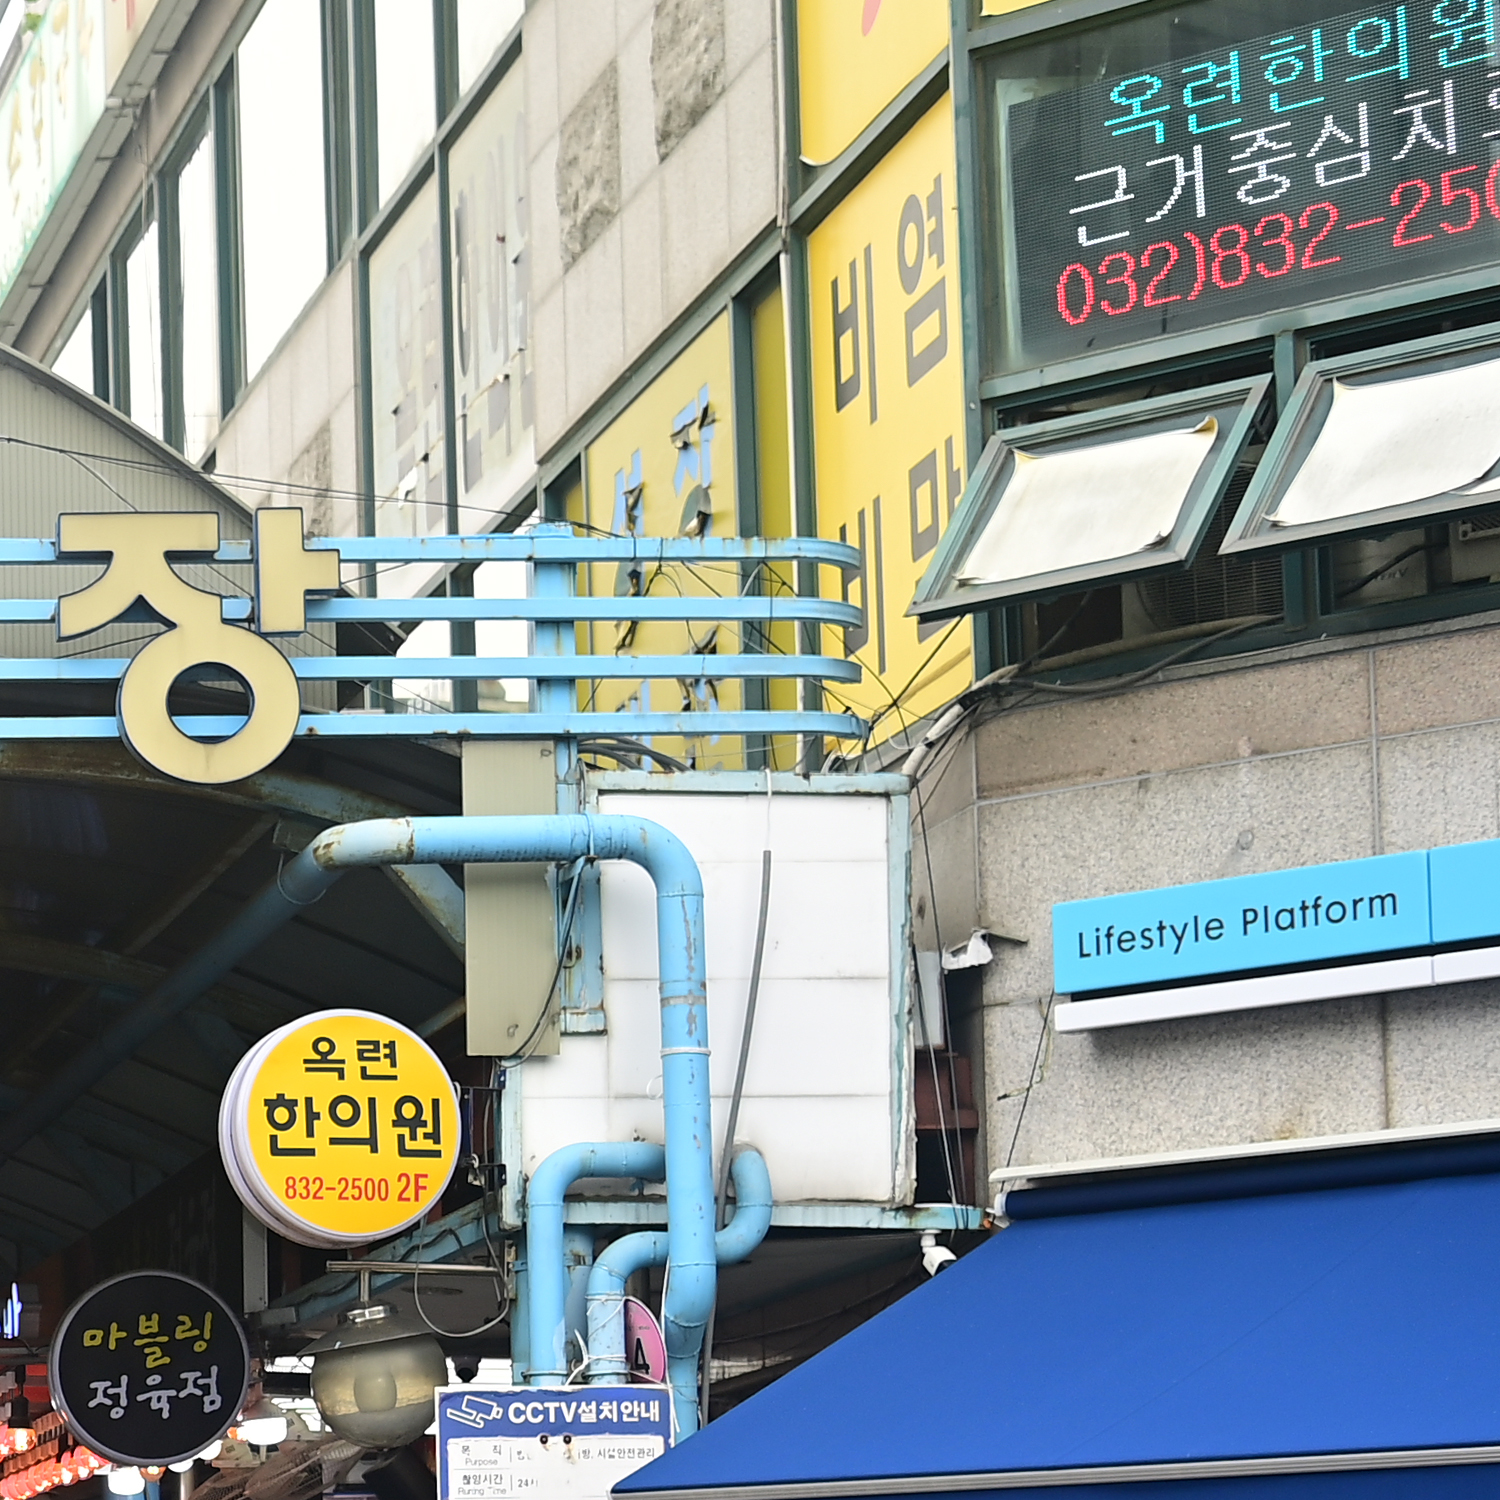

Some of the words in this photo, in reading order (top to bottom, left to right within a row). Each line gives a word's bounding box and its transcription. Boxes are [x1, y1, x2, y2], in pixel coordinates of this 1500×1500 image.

[830, 172, 948, 425] 비염
[1078, 914, 1226, 959] Lifestyle
[1242, 891, 1399, 937] Platform
[302, 1035, 399, 1082] 옥련
[263, 1092, 443, 1160] 한의원
[284, 1175, 390, 1203] 832-2500
[396, 1172, 429, 1203] 2F
[82, 1310, 214, 1369] 마블링
[88, 1365, 225, 1420] 정육점
[507, 1399, 660, 1425] CCTV설치안내
